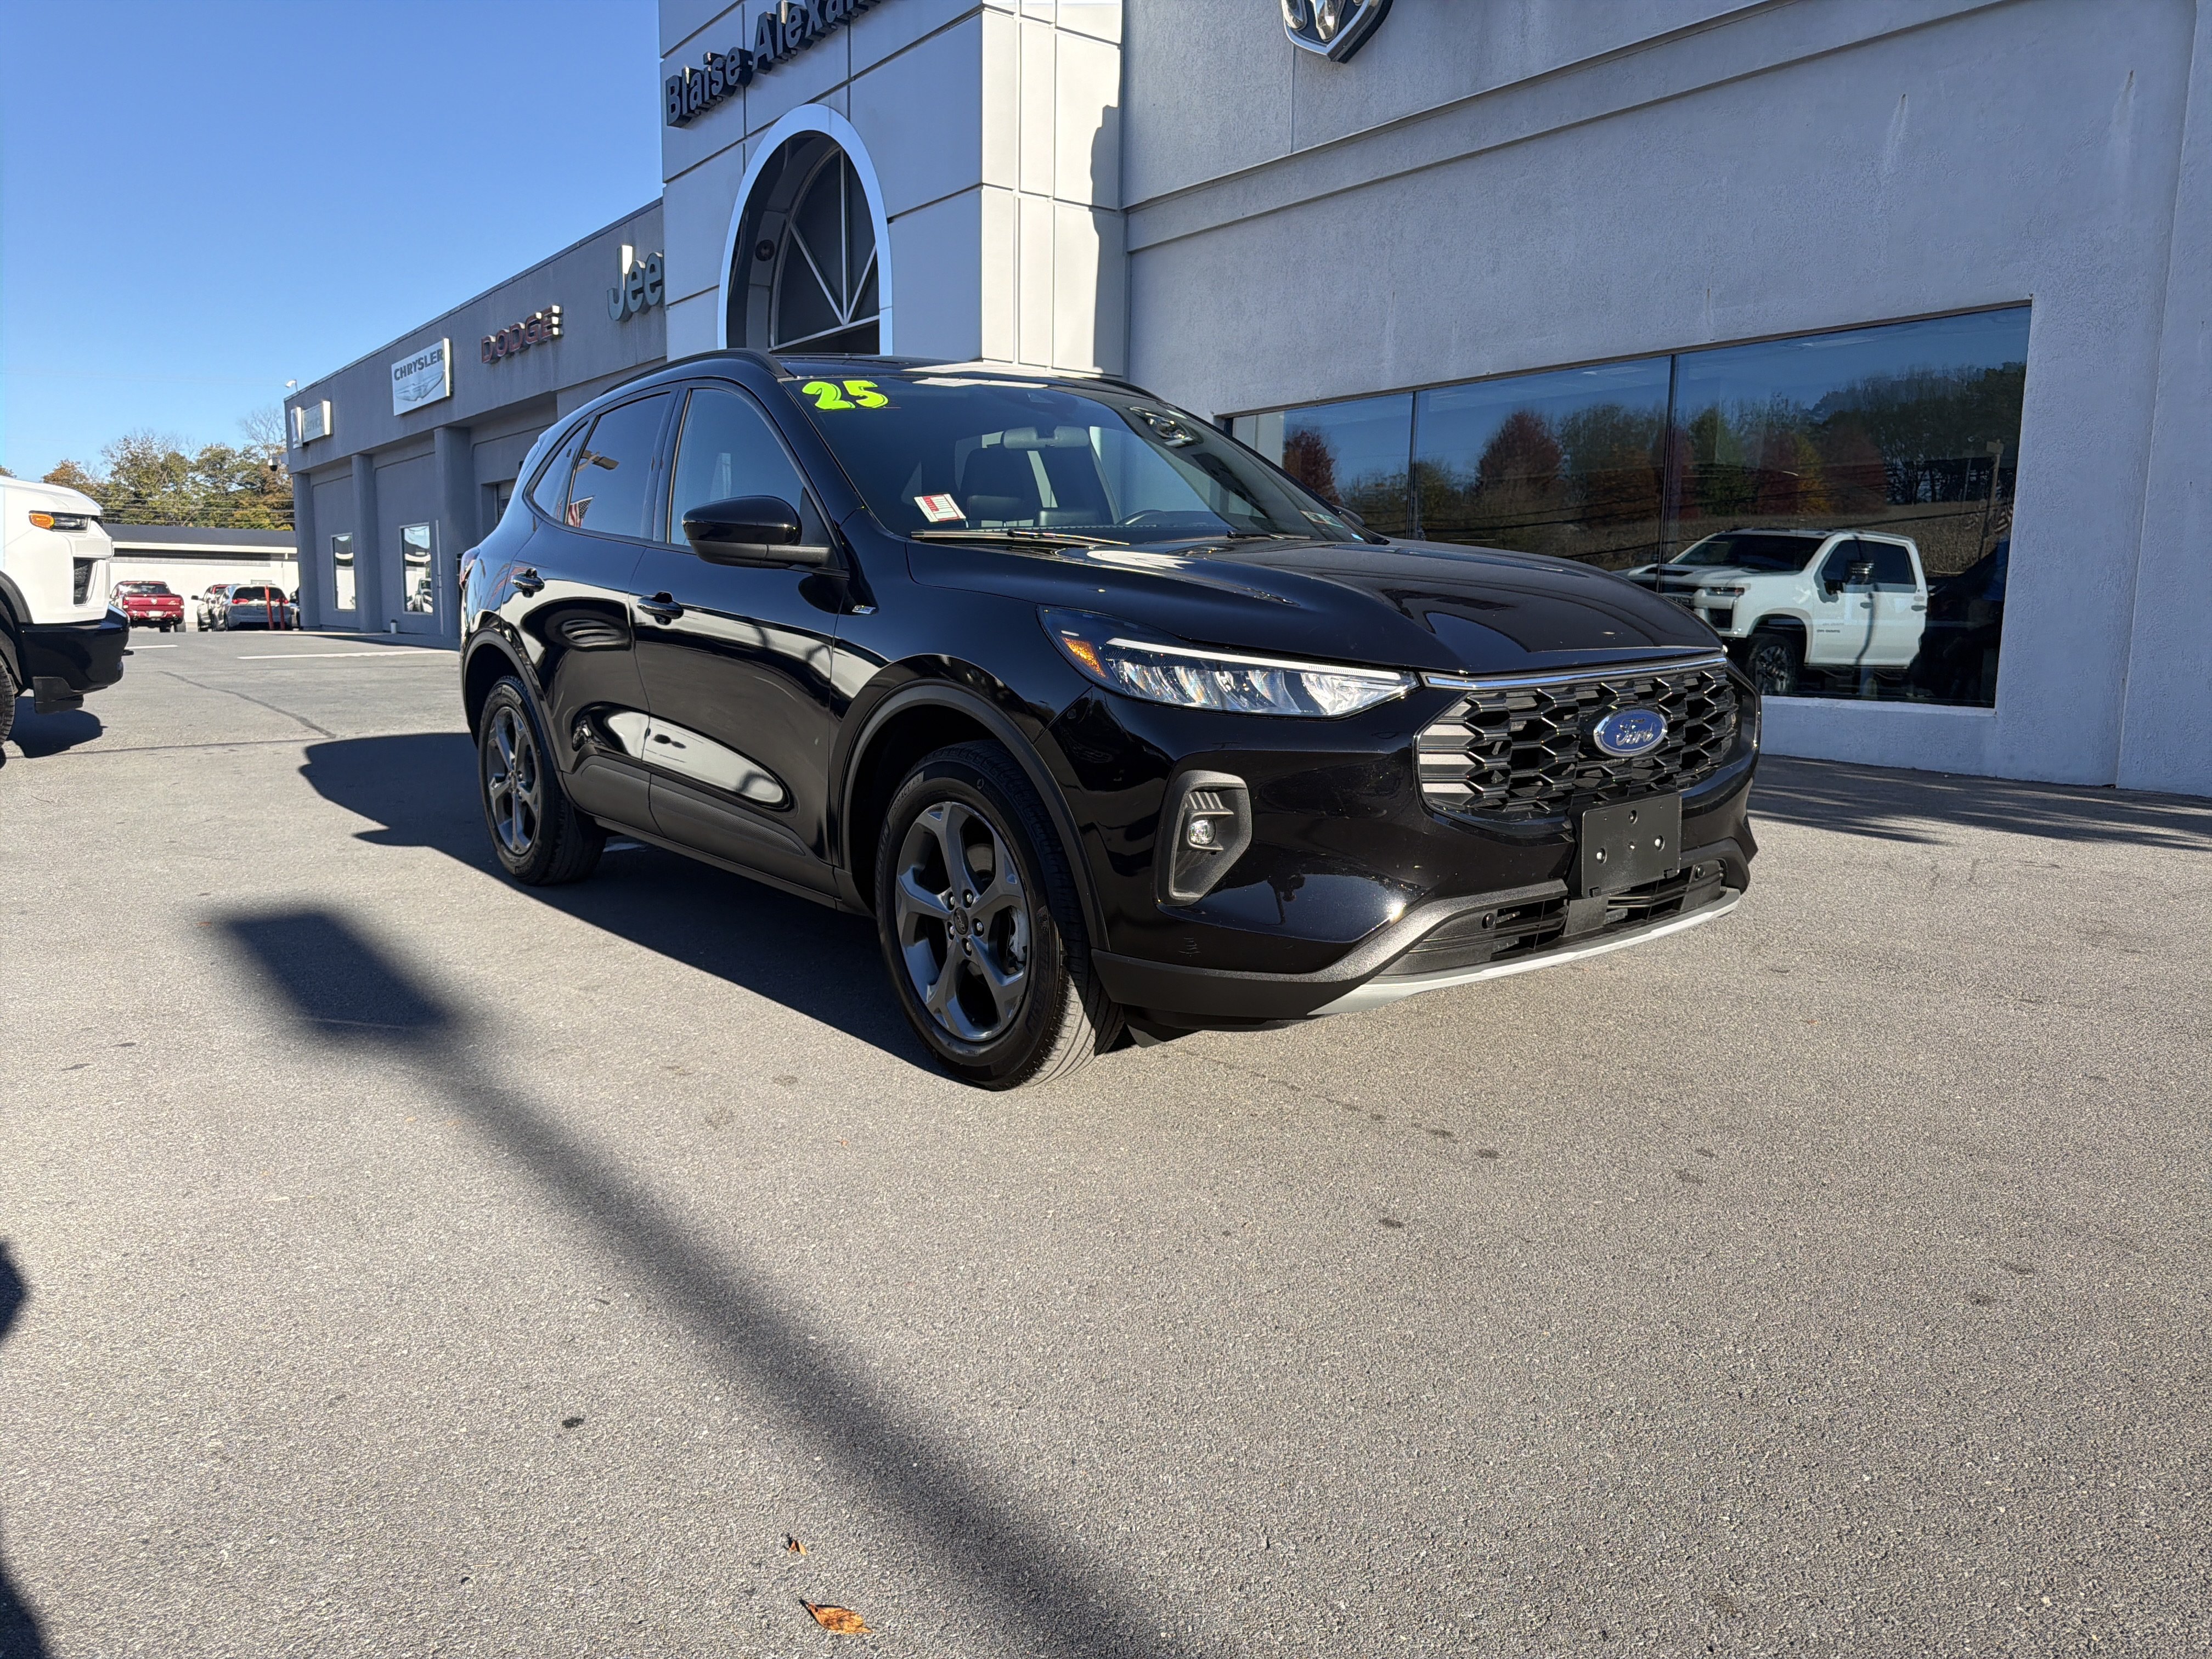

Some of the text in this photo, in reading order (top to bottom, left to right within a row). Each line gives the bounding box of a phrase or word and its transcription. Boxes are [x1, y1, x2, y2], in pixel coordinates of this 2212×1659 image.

[665, 0, 866, 126] Blaise Alexa
[607, 245, 665, 321] Jee
[481, 305, 562, 363] DODGE
[394, 348, 443, 381] CHRYSLER
[802, 380, 888, 410] 25
[1616, 718, 1654, 746] Ford
